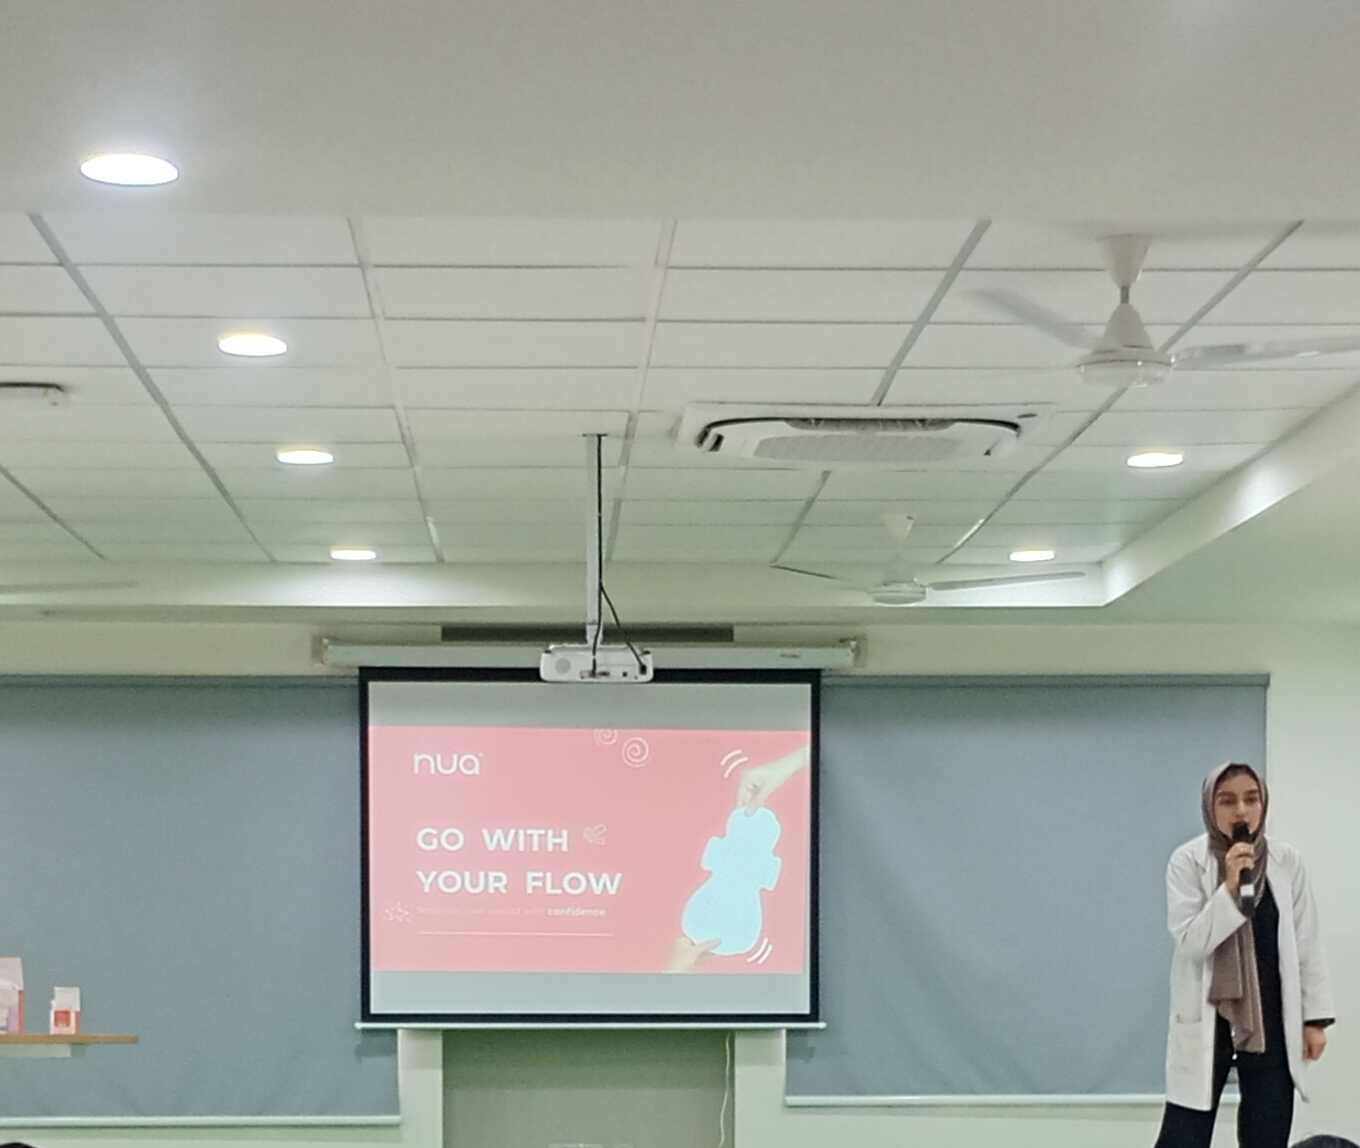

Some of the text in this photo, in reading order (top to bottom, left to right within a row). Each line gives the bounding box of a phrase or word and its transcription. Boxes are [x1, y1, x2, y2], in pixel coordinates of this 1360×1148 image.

[414, 753, 480, 775] nua
[416, 828, 569, 852] GO WITH
[416, 870, 622, 895] YOUR FLOW
[547, 906, 606, 917] confidence
